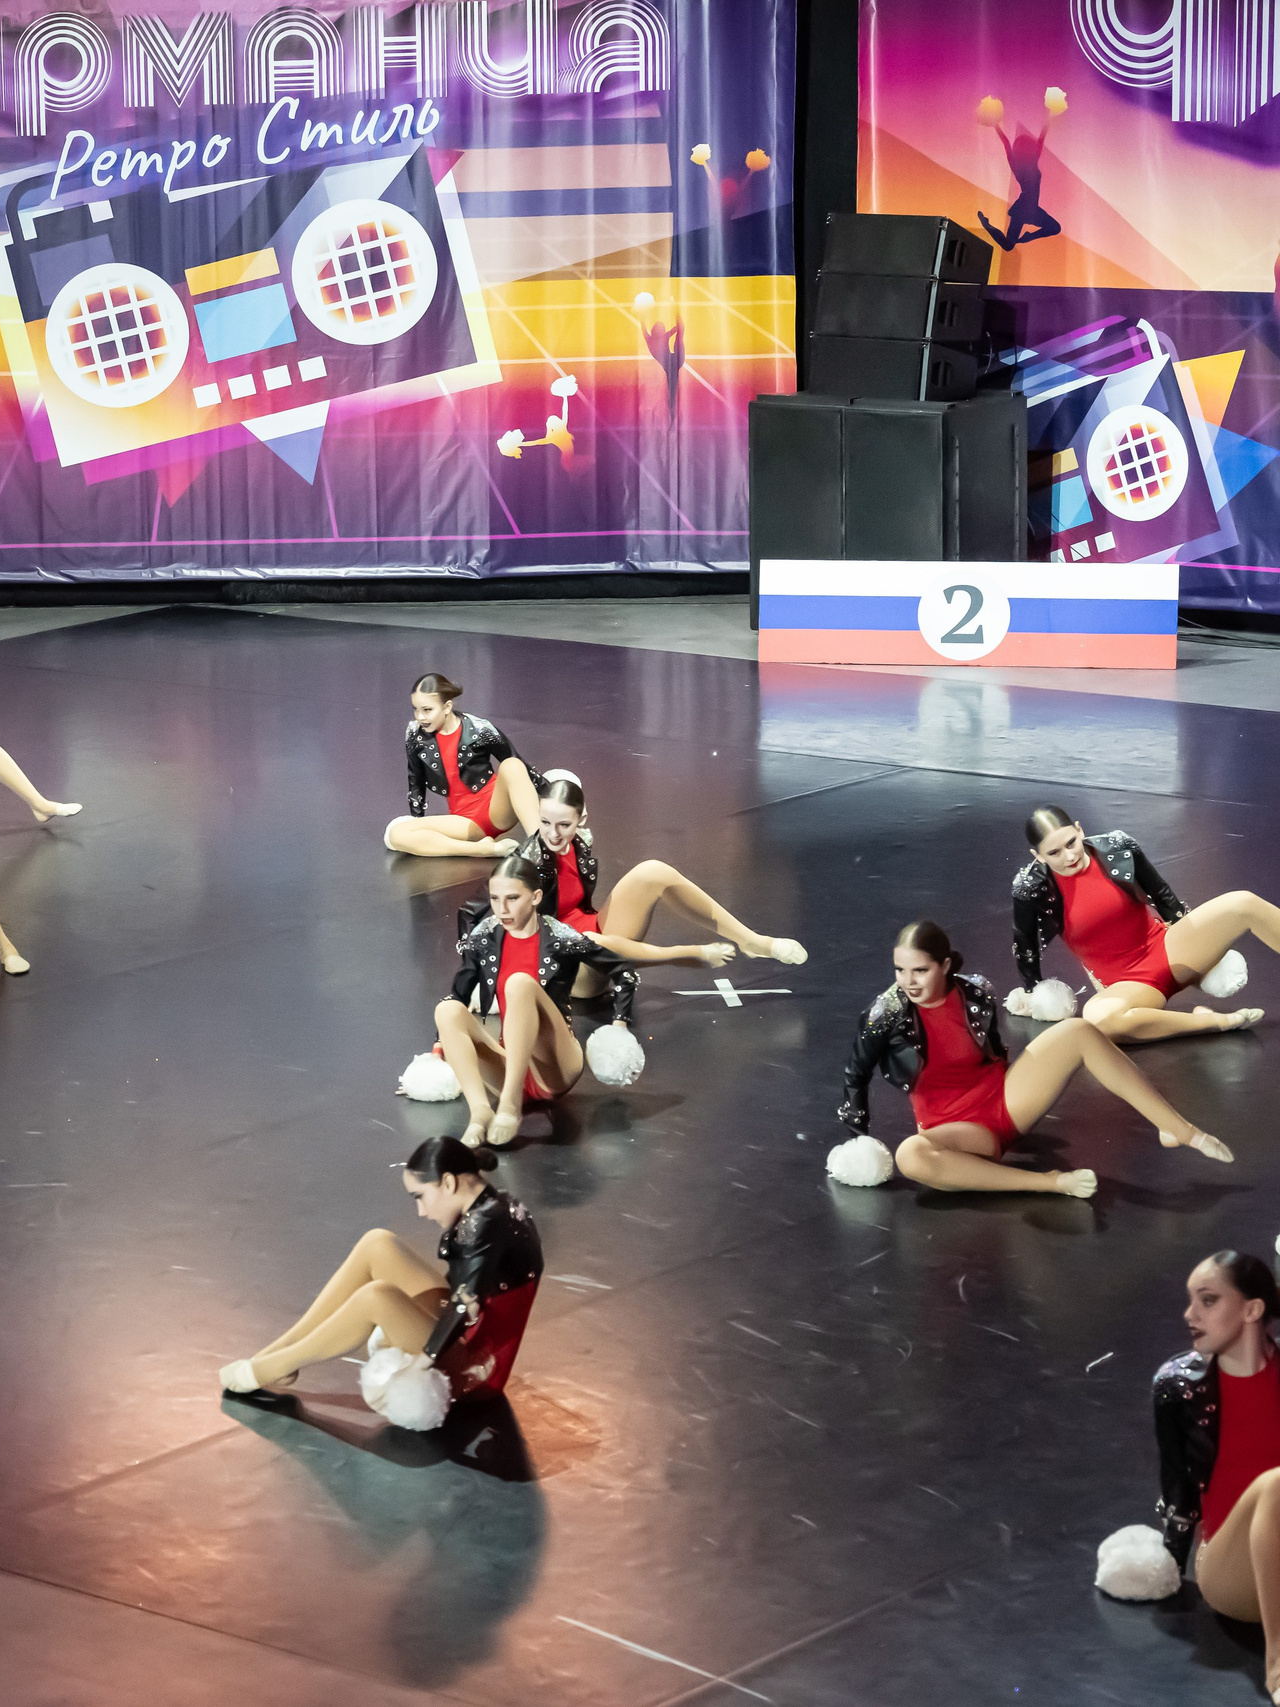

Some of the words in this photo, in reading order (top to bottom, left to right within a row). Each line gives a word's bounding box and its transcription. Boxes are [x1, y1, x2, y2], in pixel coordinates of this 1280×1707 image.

[50, 129, 232, 201] Ретро
[256, 96, 440, 164] Стиль
[941, 584, 984, 644] 2
